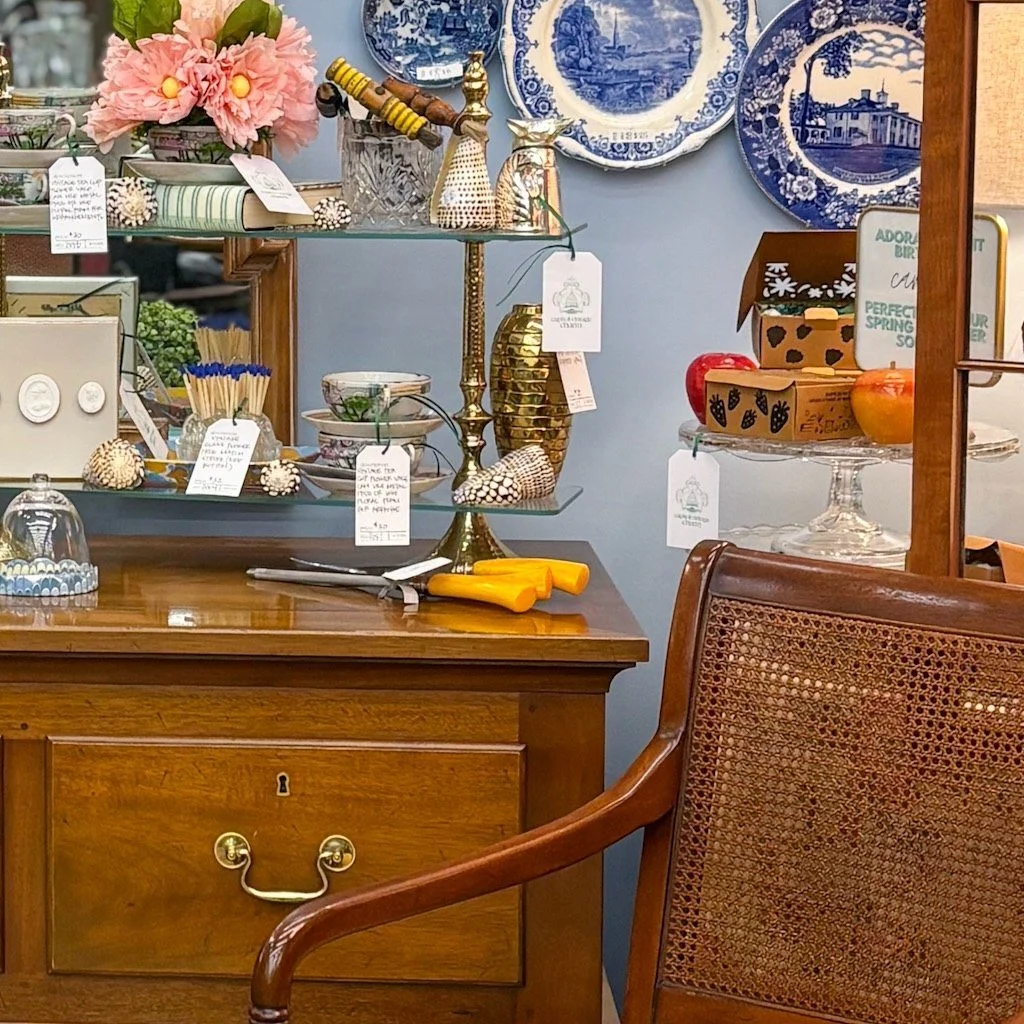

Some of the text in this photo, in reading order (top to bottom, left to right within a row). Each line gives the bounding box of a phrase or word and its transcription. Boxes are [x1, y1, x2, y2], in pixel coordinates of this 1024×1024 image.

[894, 244, 917, 260] BIR
[972, 312, 988, 328] UR
[865, 315, 986, 343] SPRING ER
[896, 334, 914, 348] SO
